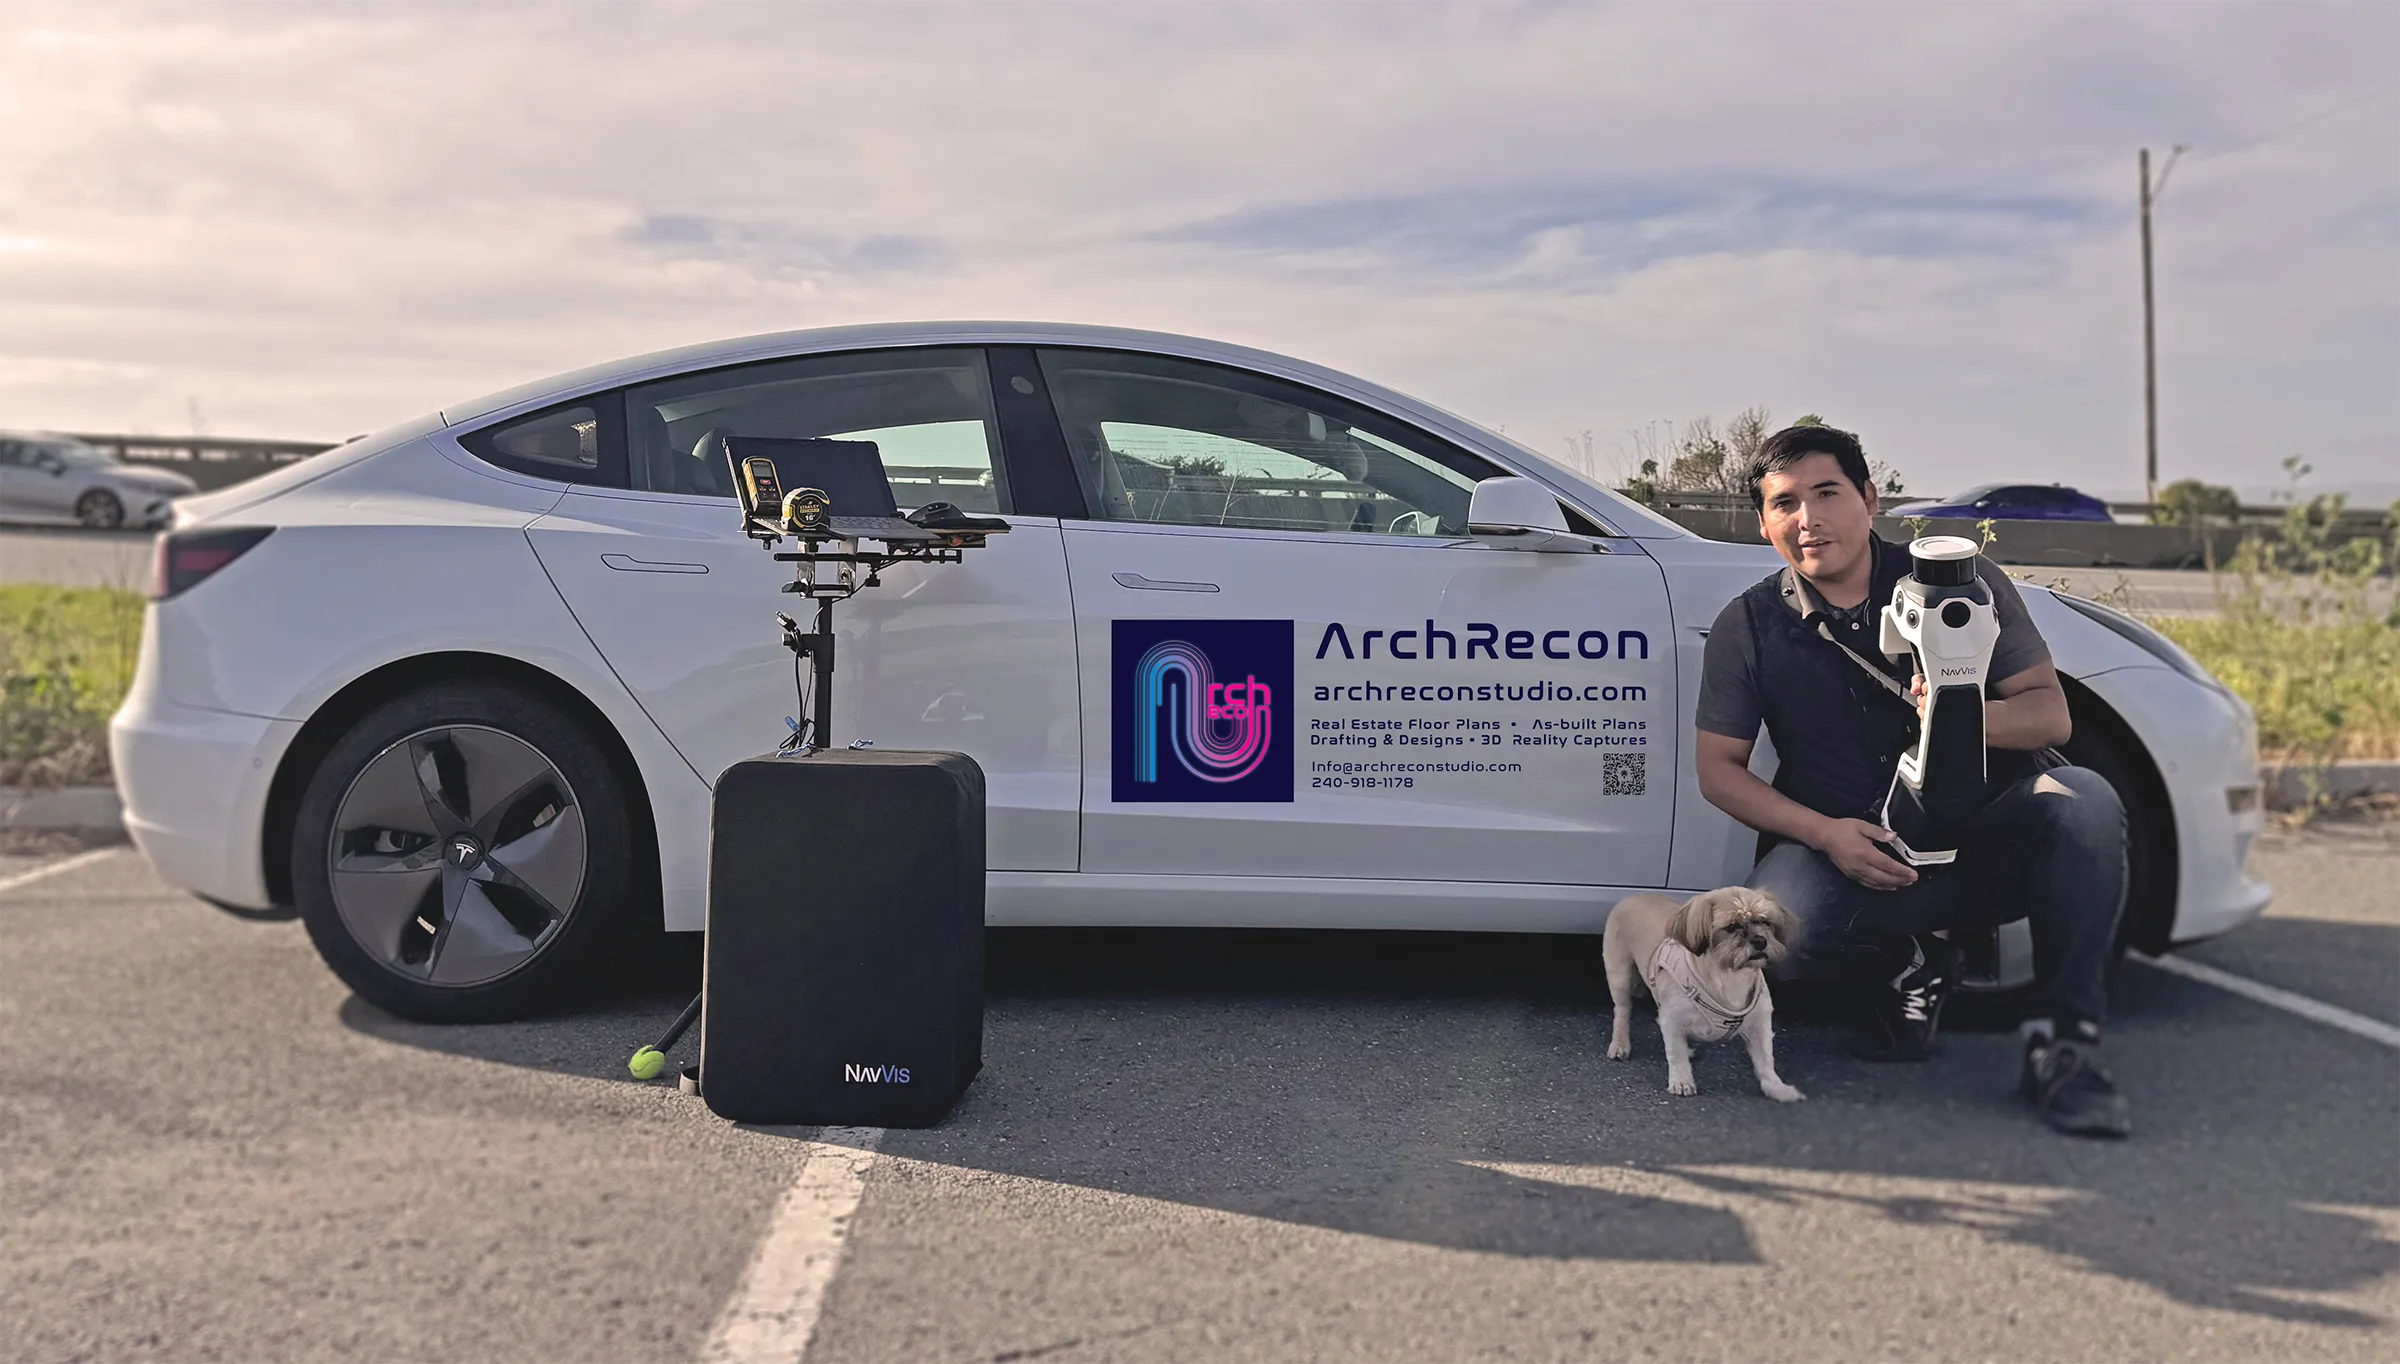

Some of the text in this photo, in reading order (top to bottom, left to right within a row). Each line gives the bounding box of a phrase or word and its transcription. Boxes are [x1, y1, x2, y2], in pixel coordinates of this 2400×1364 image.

[1316, 619, 1648, 659] ArchRecon
[1314, 681, 1646, 701] archreconstudio.com
[1312, 718, 1646, 729] Real Estate Floor Plans As-built Plans
[1311, 734, 1646, 748] Drafting & Designs 3D Reality Captures
[1313, 761, 1521, 774] Info@archreconstudio.com
[1312, 778, 1413, 787] 240-918-1178
